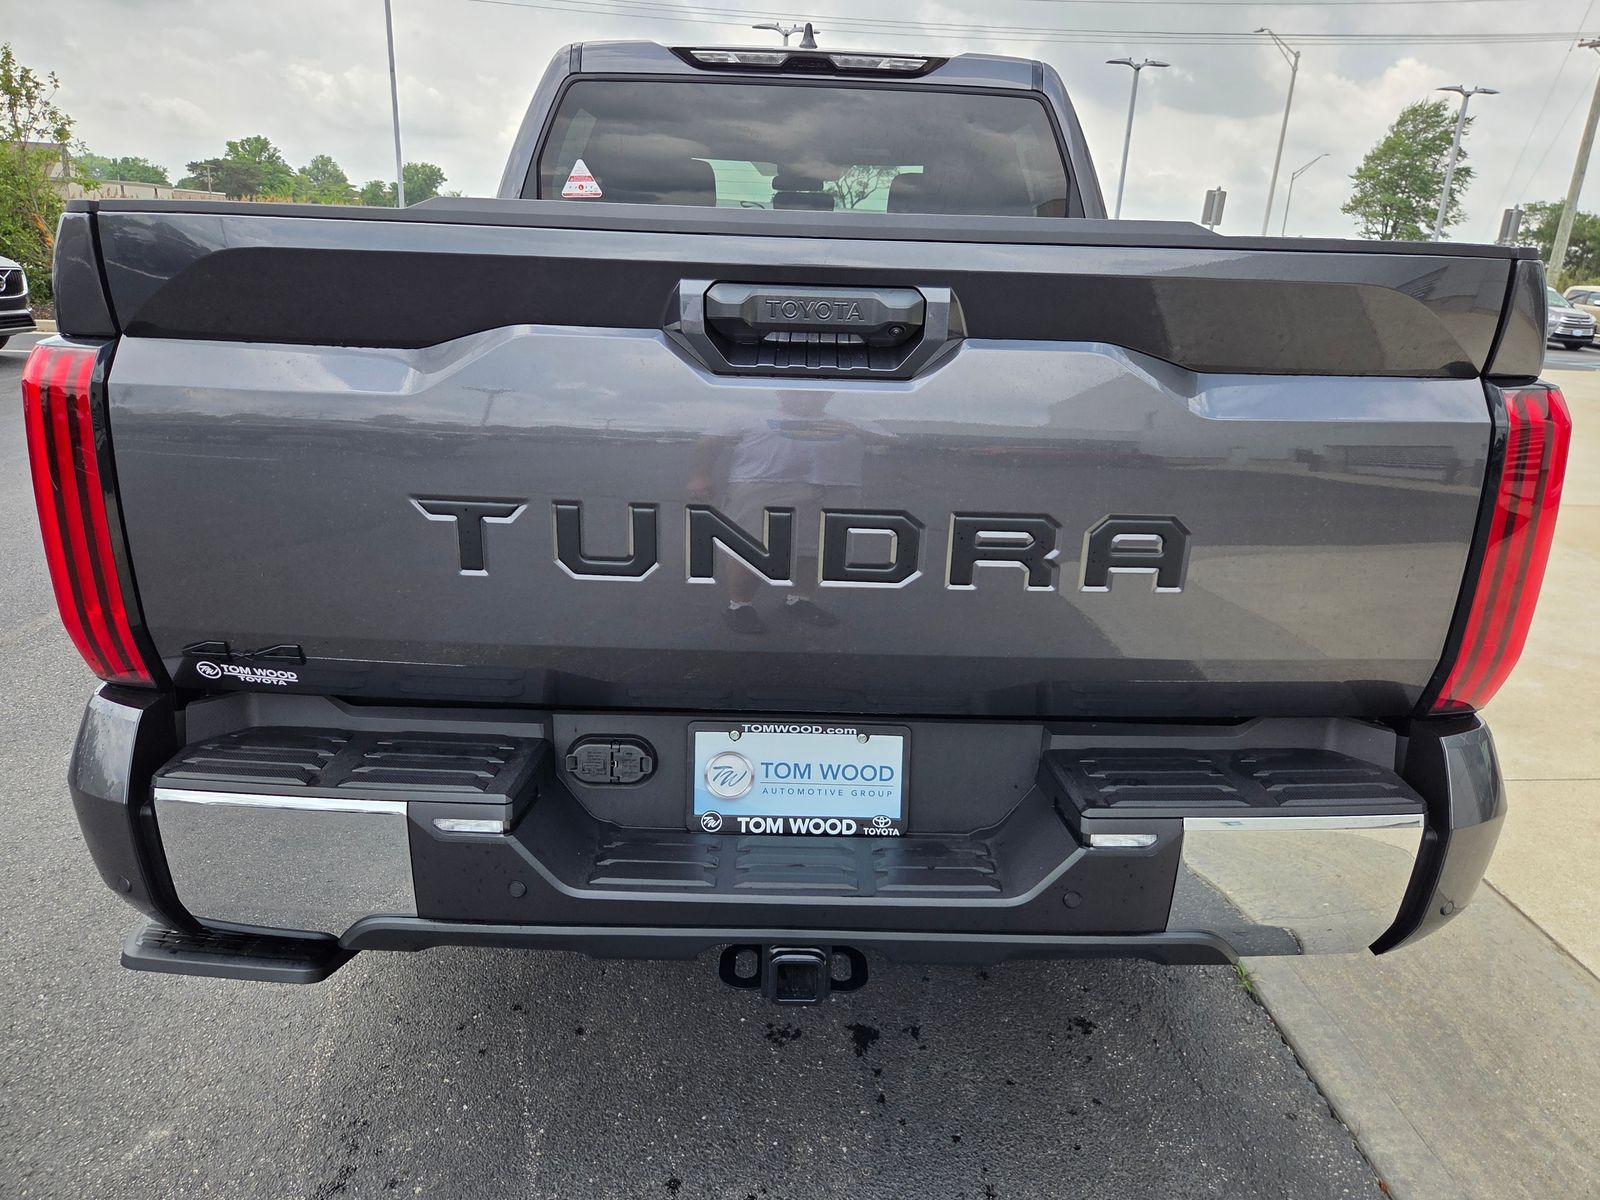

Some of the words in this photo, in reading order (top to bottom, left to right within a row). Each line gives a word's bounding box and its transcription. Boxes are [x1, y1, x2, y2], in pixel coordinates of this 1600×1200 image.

[765, 299, 865, 322] TOYOTA
[409, 495, 1193, 594] TUNDRA
[220, 663, 251, 675] TOM
[253, 667, 298, 680] WOOD
[237, 674, 288, 686] TOYOTA
[741, 723, 857, 736] TOMWOOD.com
[760, 761, 812, 780] TOM
[819, 762, 895, 782] WOOD
[762, 786, 844, 797] AUTOMOTIVE
[850, 789, 893, 798] GROUP
[737, 816, 784, 834] TOM
[788, 817, 857, 836] WOOD
[863, 826, 900, 837] TOYOTA
